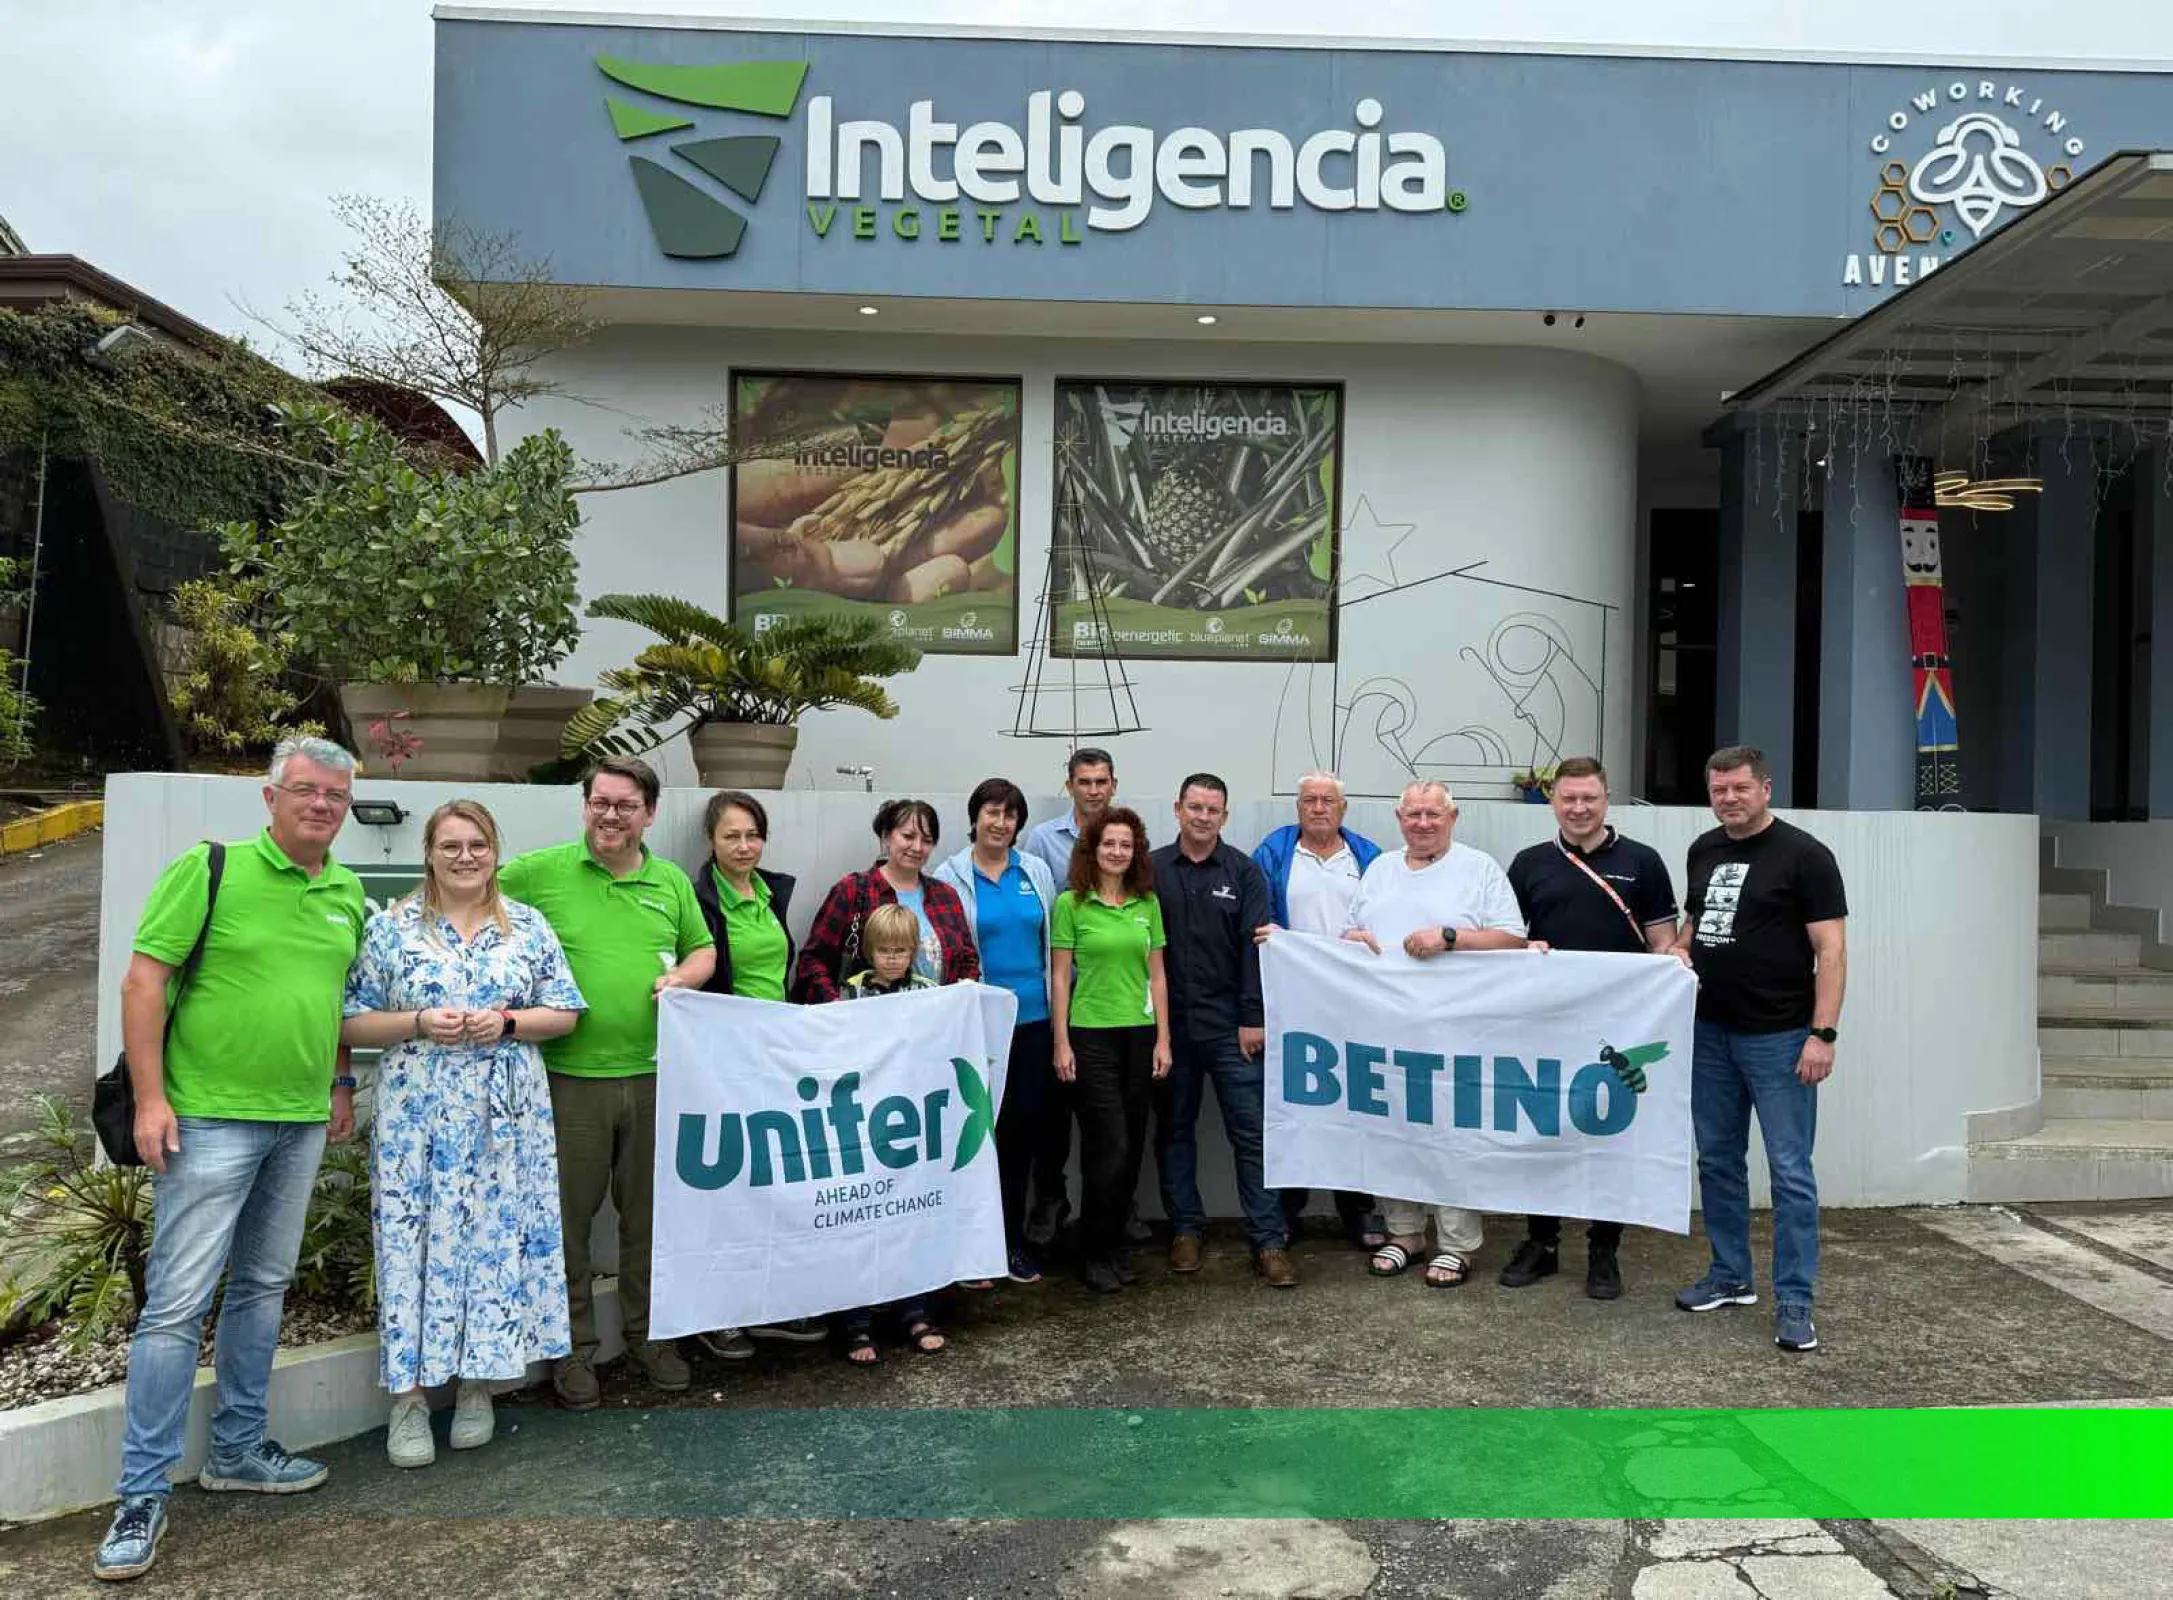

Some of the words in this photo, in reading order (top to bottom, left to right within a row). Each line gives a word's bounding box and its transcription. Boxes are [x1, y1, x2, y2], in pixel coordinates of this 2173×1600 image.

[1870, 80, 2085, 157] COWORKING
[806, 203, 1083, 244] VEGETAL
[1842, 253, 1953, 286] AVEN
[1143, 409, 1291, 440] Inteligencia
[1282, 1031, 1639, 1137] BETINO
[814, 1203, 882, 1229] CLIMATE
[886, 1190, 943, 1217] CHANGE
[815, 1183, 870, 1207] AHEAD
[874, 1179, 896, 1196] OF
